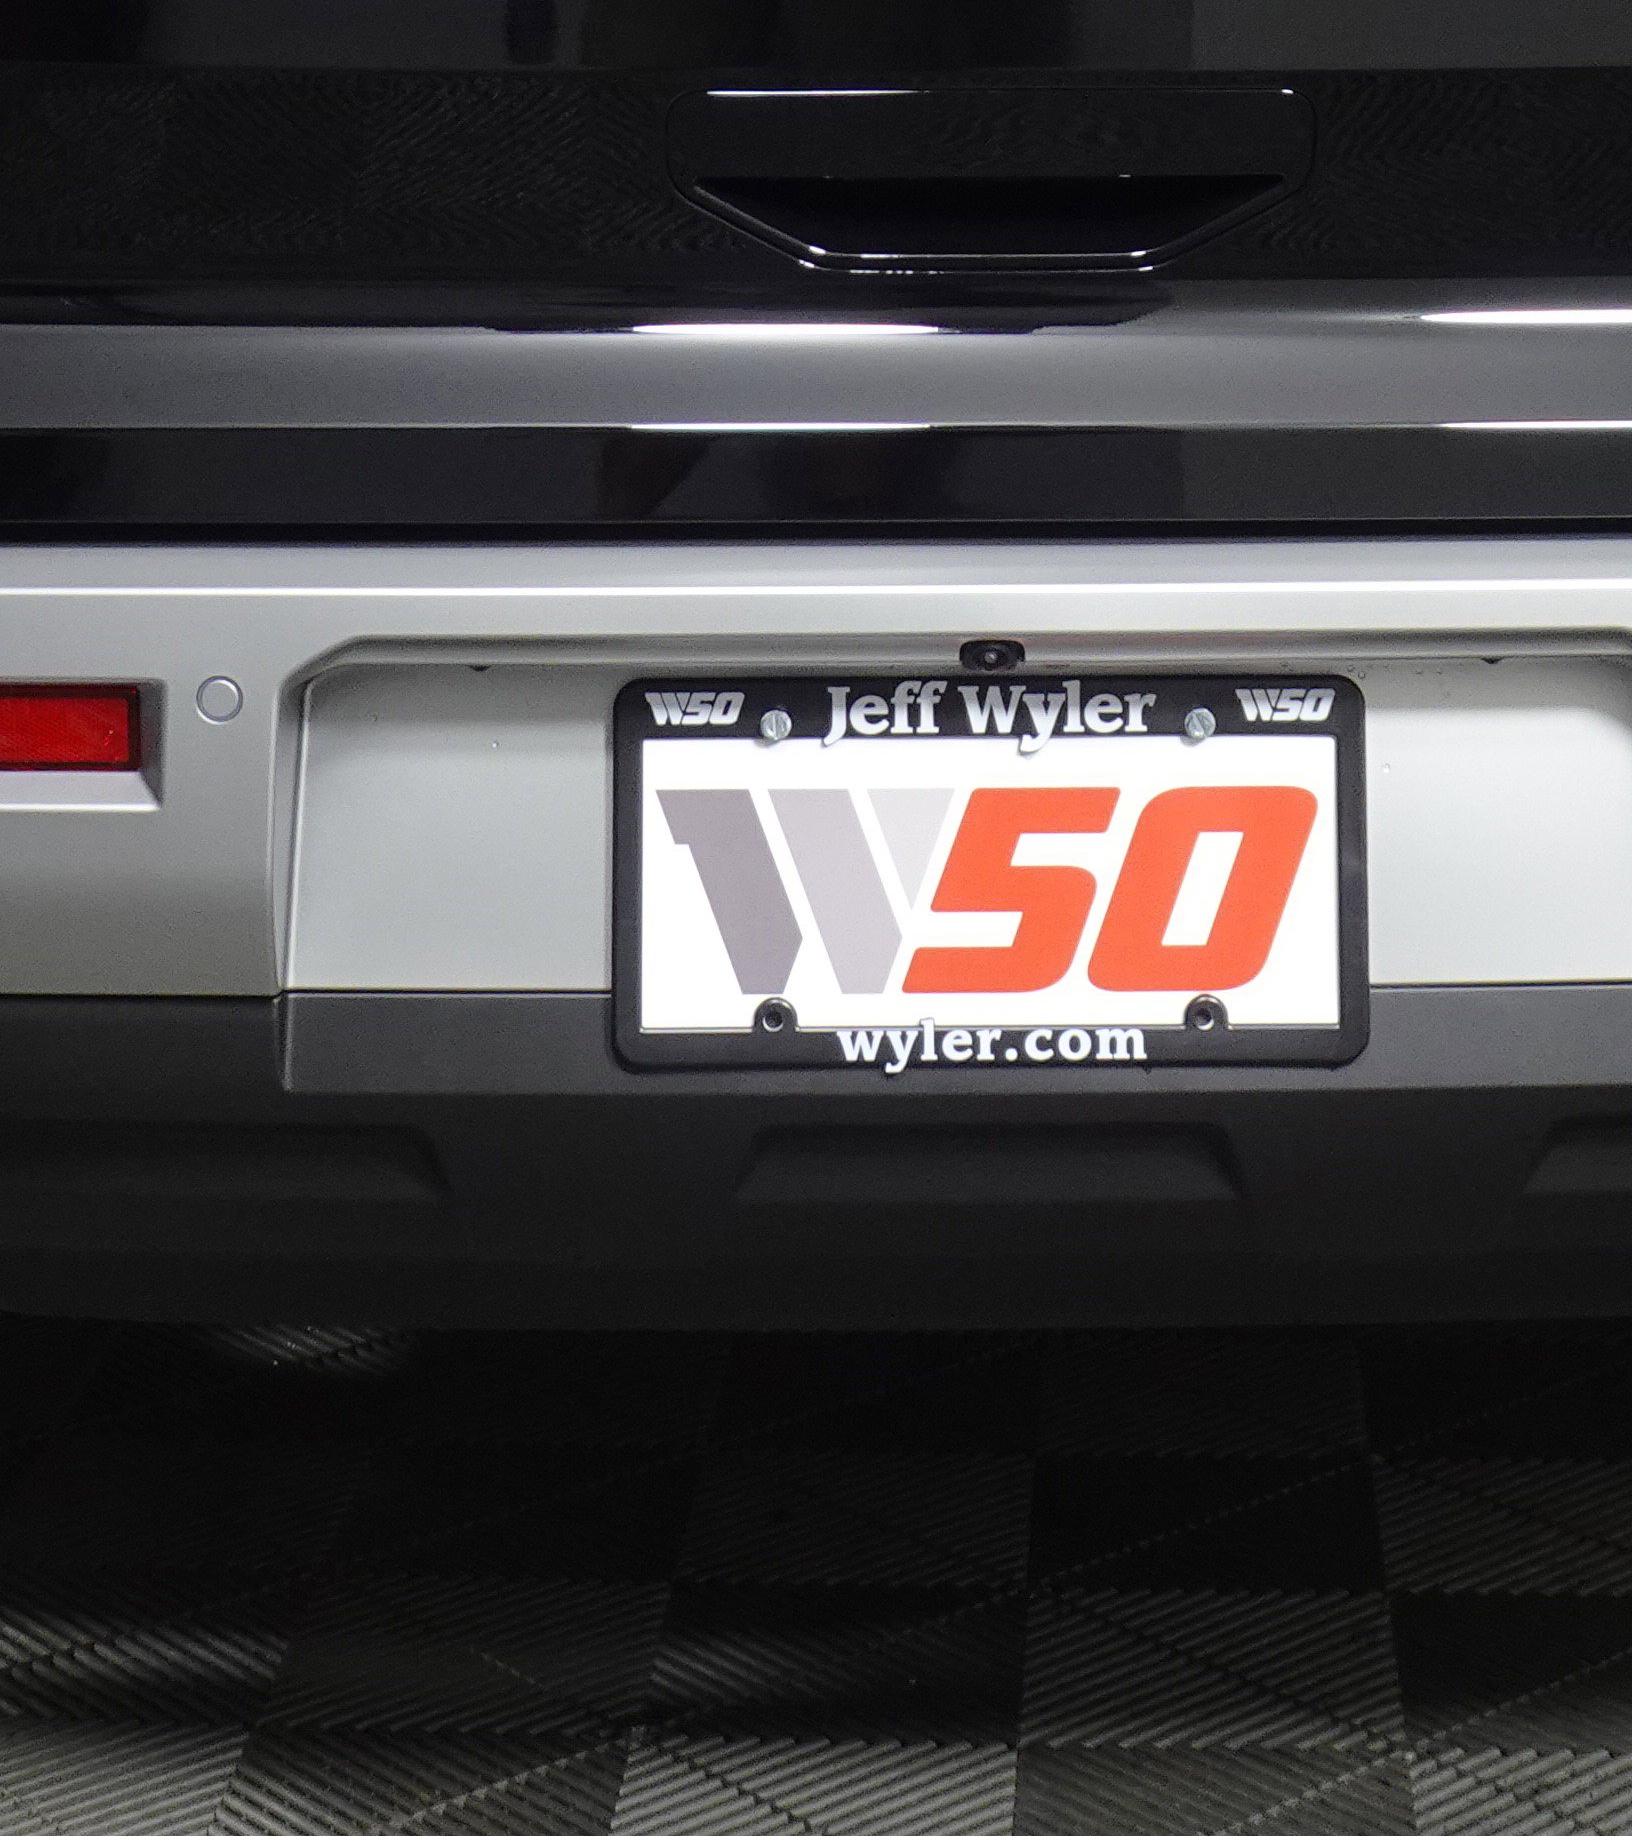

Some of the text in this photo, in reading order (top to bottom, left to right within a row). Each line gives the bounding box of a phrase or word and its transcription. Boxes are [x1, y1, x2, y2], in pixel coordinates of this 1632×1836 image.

[644, 691, 746, 726] W50
[822, 679, 1157, 754] Jeff Wyler
[1234, 687, 1337, 722] W50
[655, 785, 1319, 995] W50
[836, 1016, 1147, 1073] wyler.com
